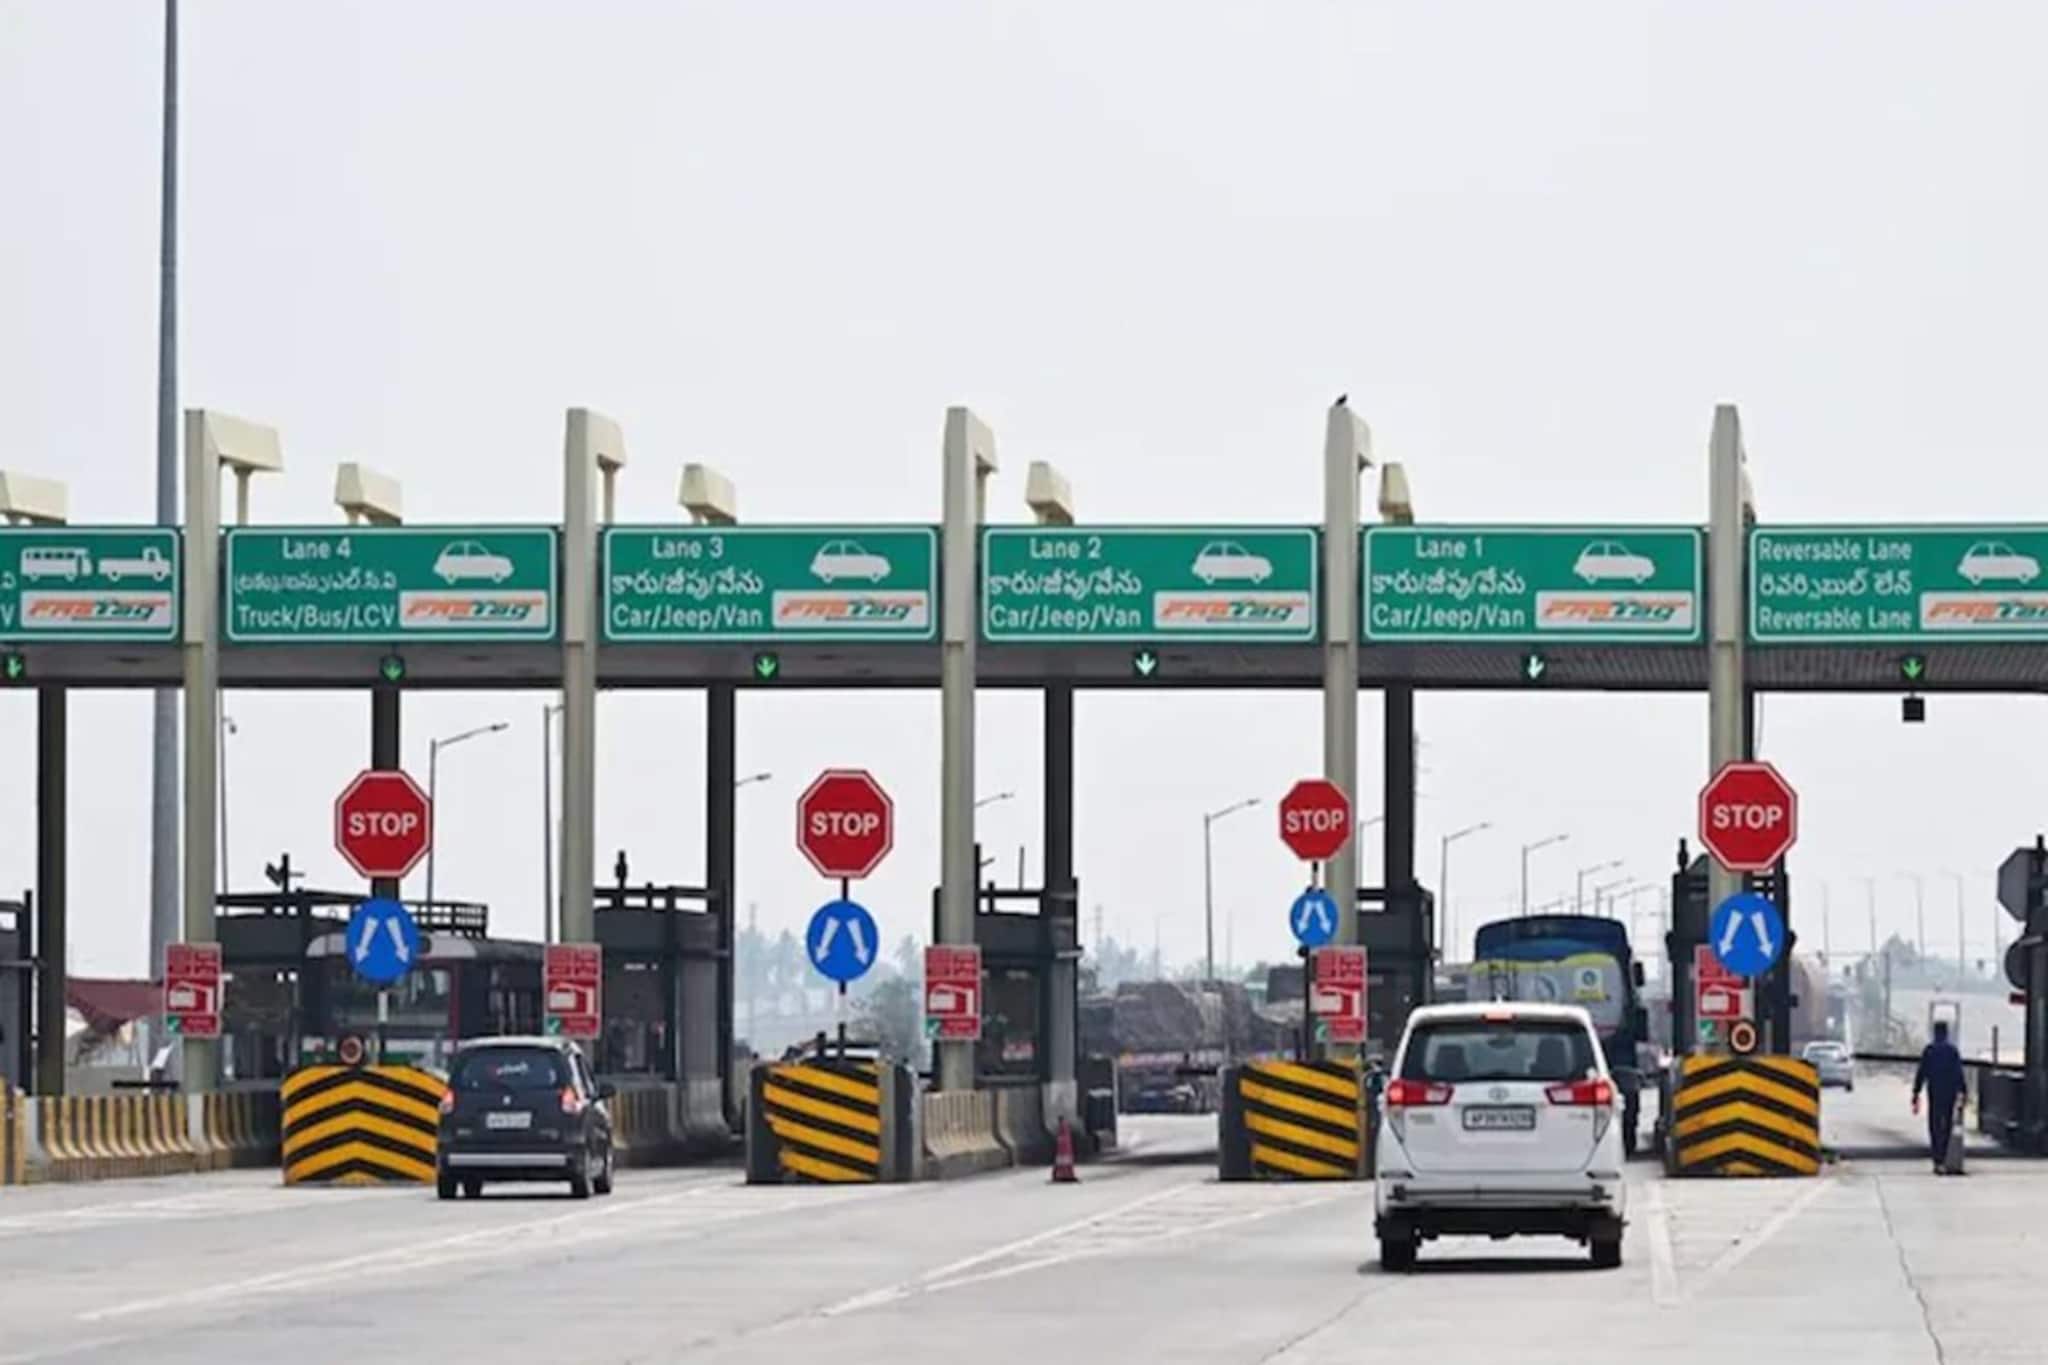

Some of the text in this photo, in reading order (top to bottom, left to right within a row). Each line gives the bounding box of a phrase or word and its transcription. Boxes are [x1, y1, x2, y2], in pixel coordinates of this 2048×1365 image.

[283, 537, 351, 559] Lane 4
[652, 537, 724, 558] Lane 3
[1030, 537, 1102, 559] Lane 2
[1416, 537, 1483, 558] Lane 1
[1759, 538, 1912, 560] Reversable Lane
[237, 604, 396, 631] Truck/Bus/LCV
[612, 604, 763, 630] Car/Jeep/Van
[989, 604, 1142, 630] Car/Jeep/Van
[1372, 604, 1525, 630] Car/Jeep/Van
[1759, 606, 1912, 630] Reversable Lane
[349, 811, 418, 836] STOP
[810, 811, 880, 836] STOP
[1286, 809, 1344, 833] STOP
[1712, 804, 1783, 829] STOP
